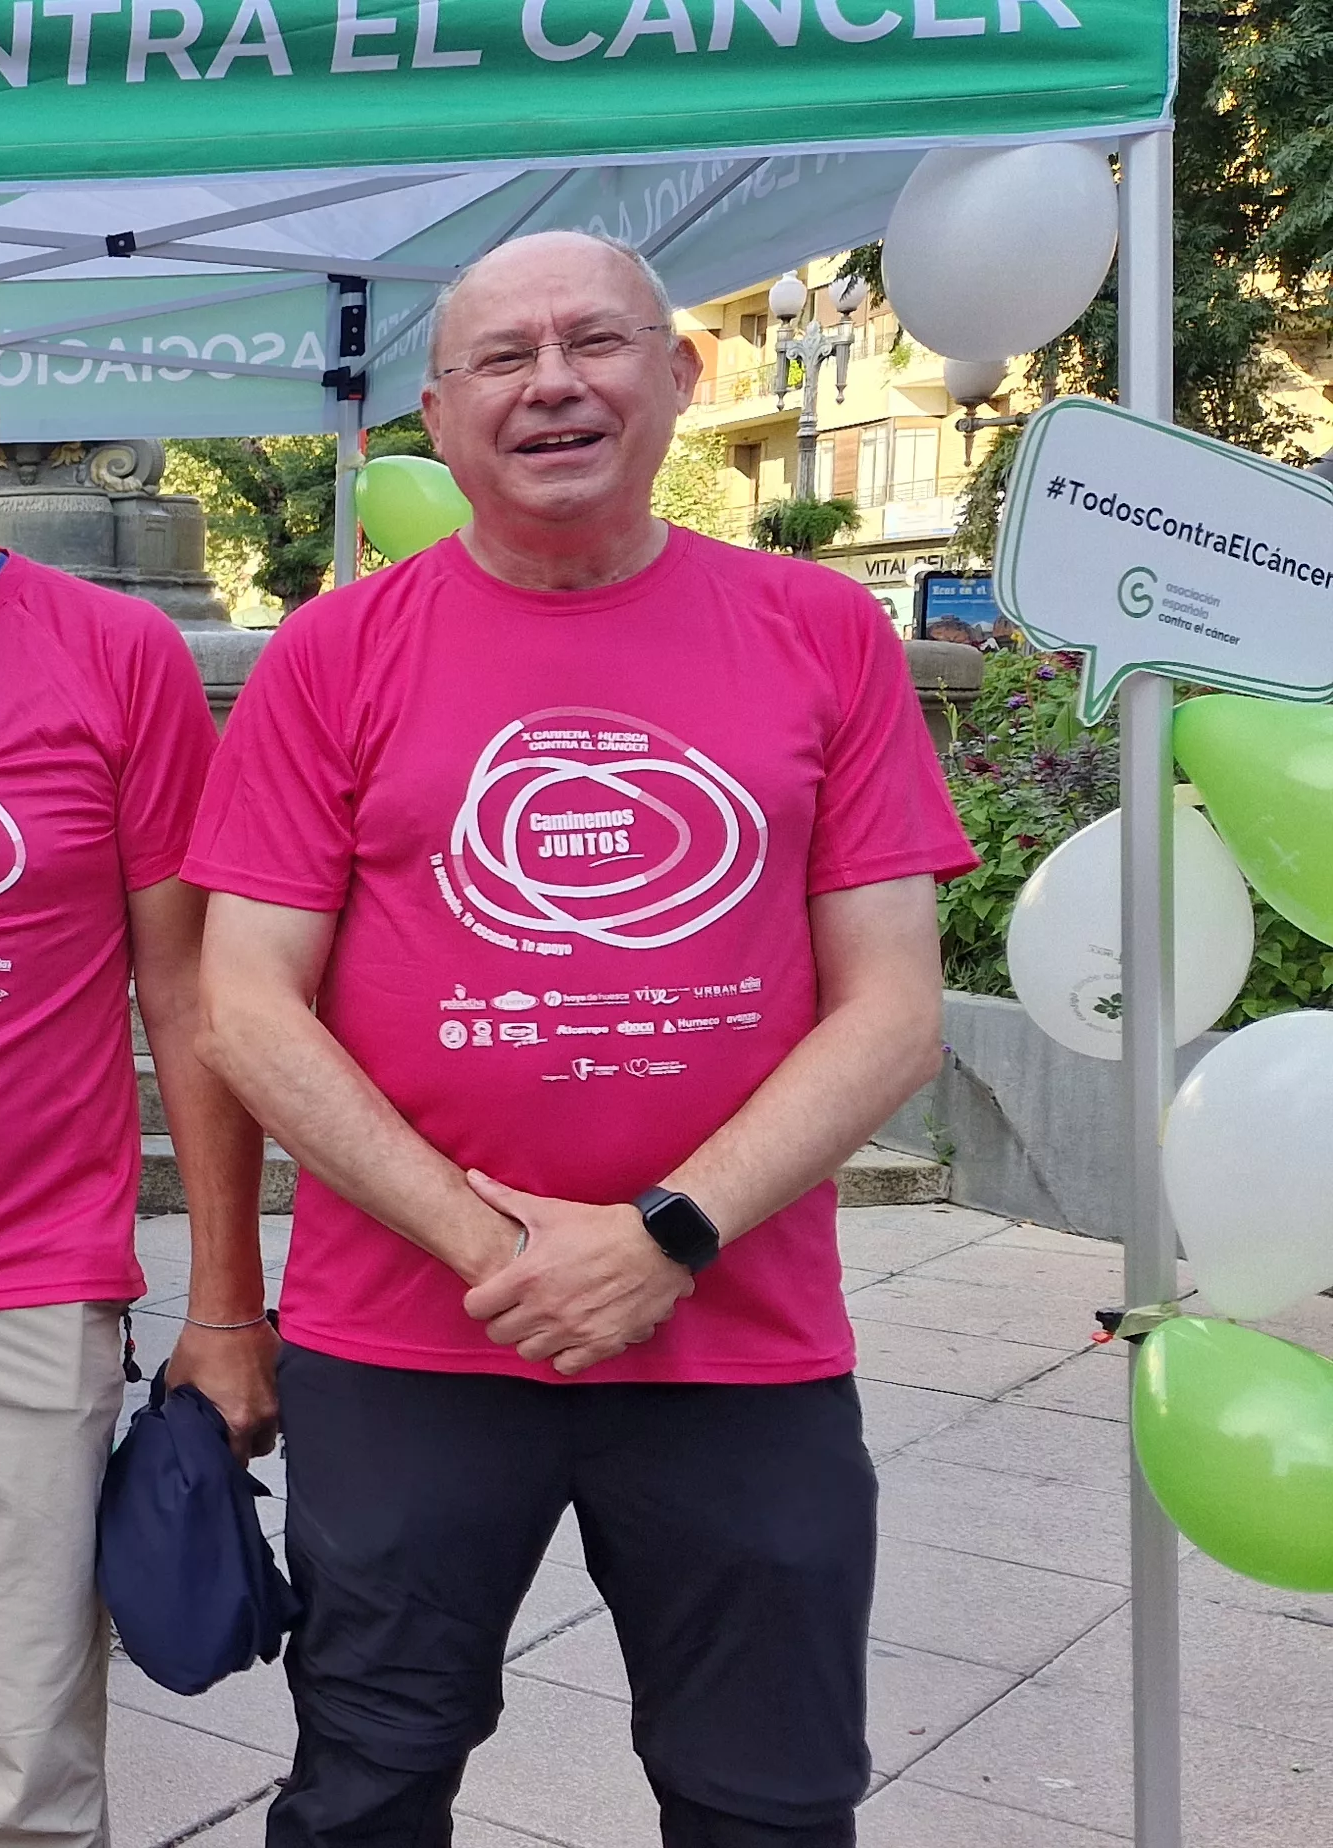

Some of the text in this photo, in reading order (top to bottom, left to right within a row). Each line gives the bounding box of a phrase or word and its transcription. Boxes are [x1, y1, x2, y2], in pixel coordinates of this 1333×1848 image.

[331, 0, 482, 72] EL
[1046, 475, 1333, 589] #TodosContraElCáncer
[1166, 581, 1221, 607] asociación
[1162, 596, 1209, 620] española
[1158, 612, 1241, 646] contra el cáncer
[529, 809, 634, 832] Caminemos
[538, 831, 630, 858] JUNTOS
[634, 986, 680, 1005] vive
[694, 984, 737, 996] URBAN
